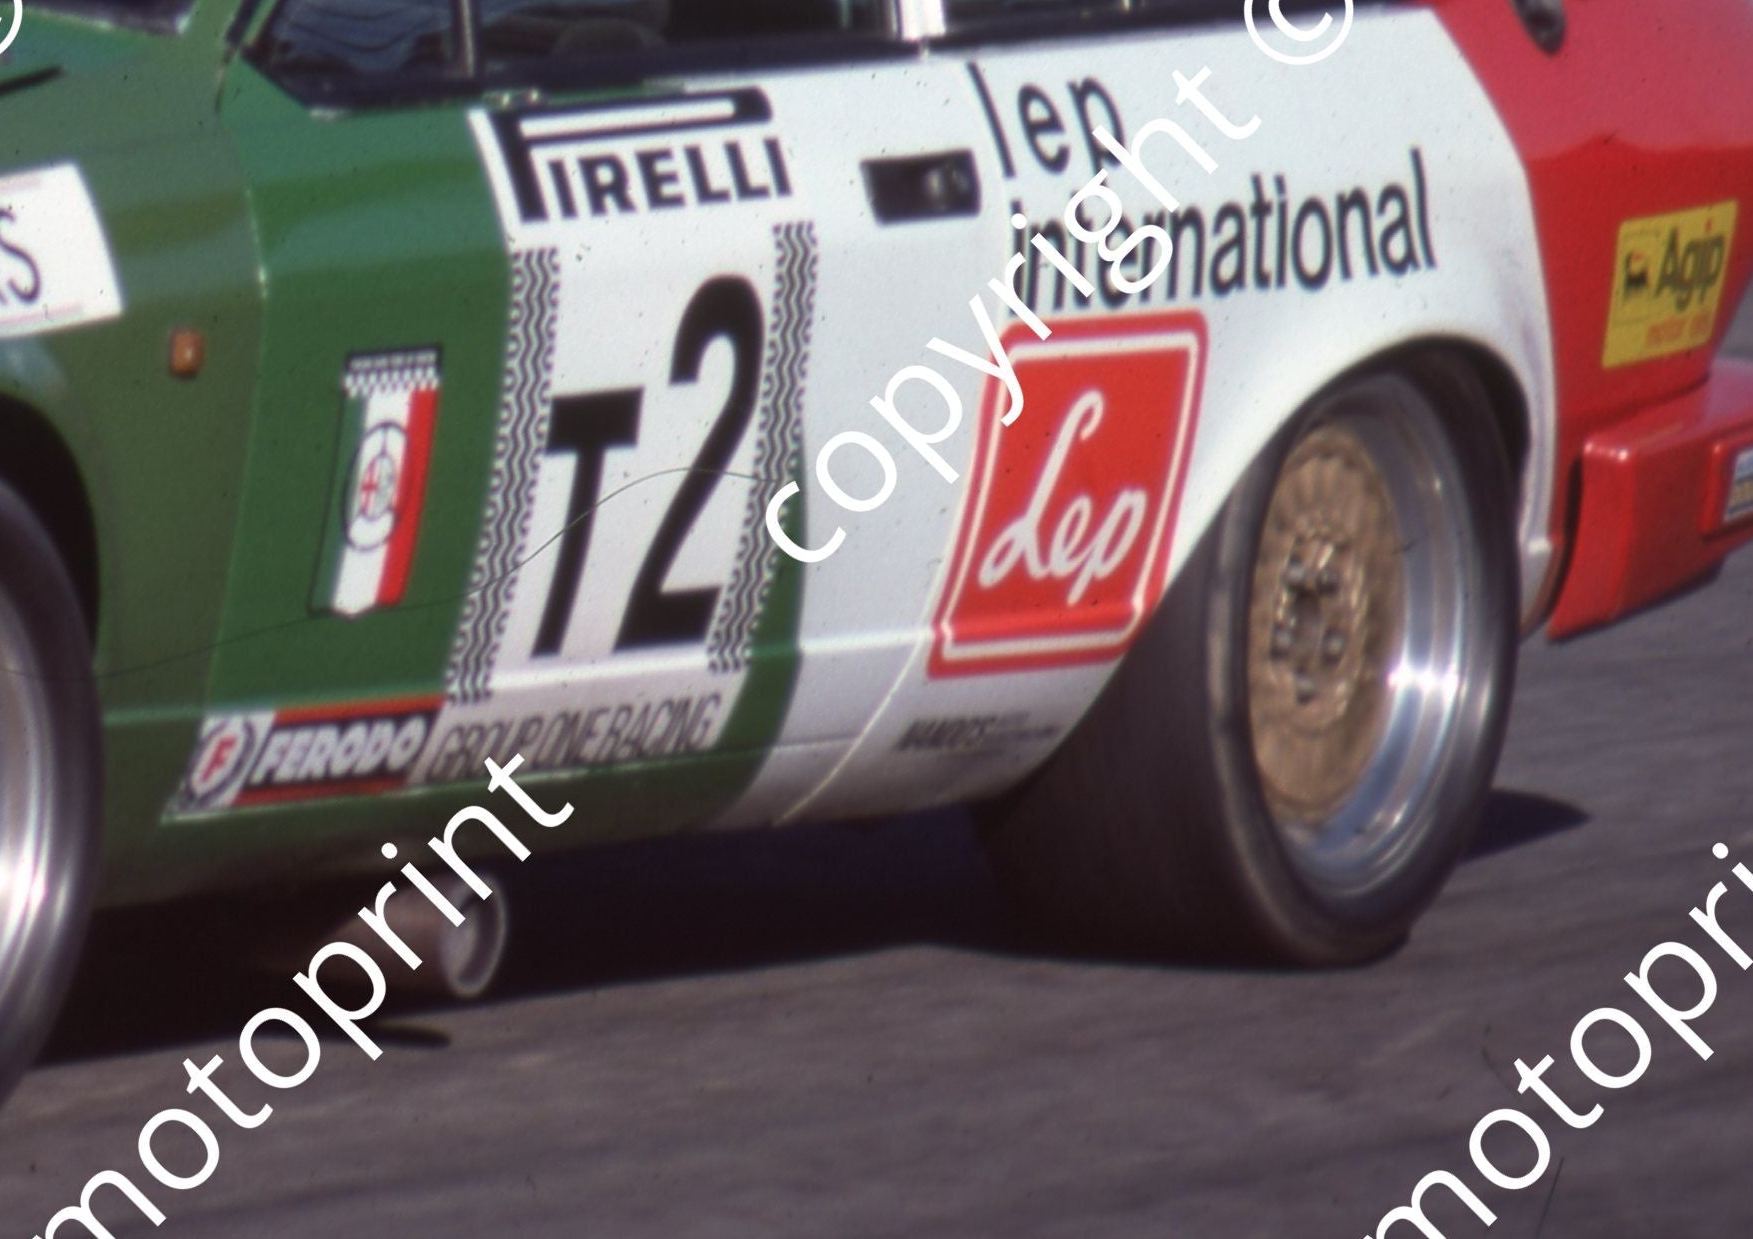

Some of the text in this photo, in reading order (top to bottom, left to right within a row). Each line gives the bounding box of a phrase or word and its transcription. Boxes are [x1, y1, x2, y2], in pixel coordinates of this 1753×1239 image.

[488, 85, 793, 223] PIRELLI
[967, 61, 1126, 186] lep
[1009, 147, 1437, 315] international
[1653, 217, 1726, 314] Agip
[530, 273, 765, 658] T2
[978, 388, 1148, 607] Lep
[249, 716, 428, 784] FERODO
